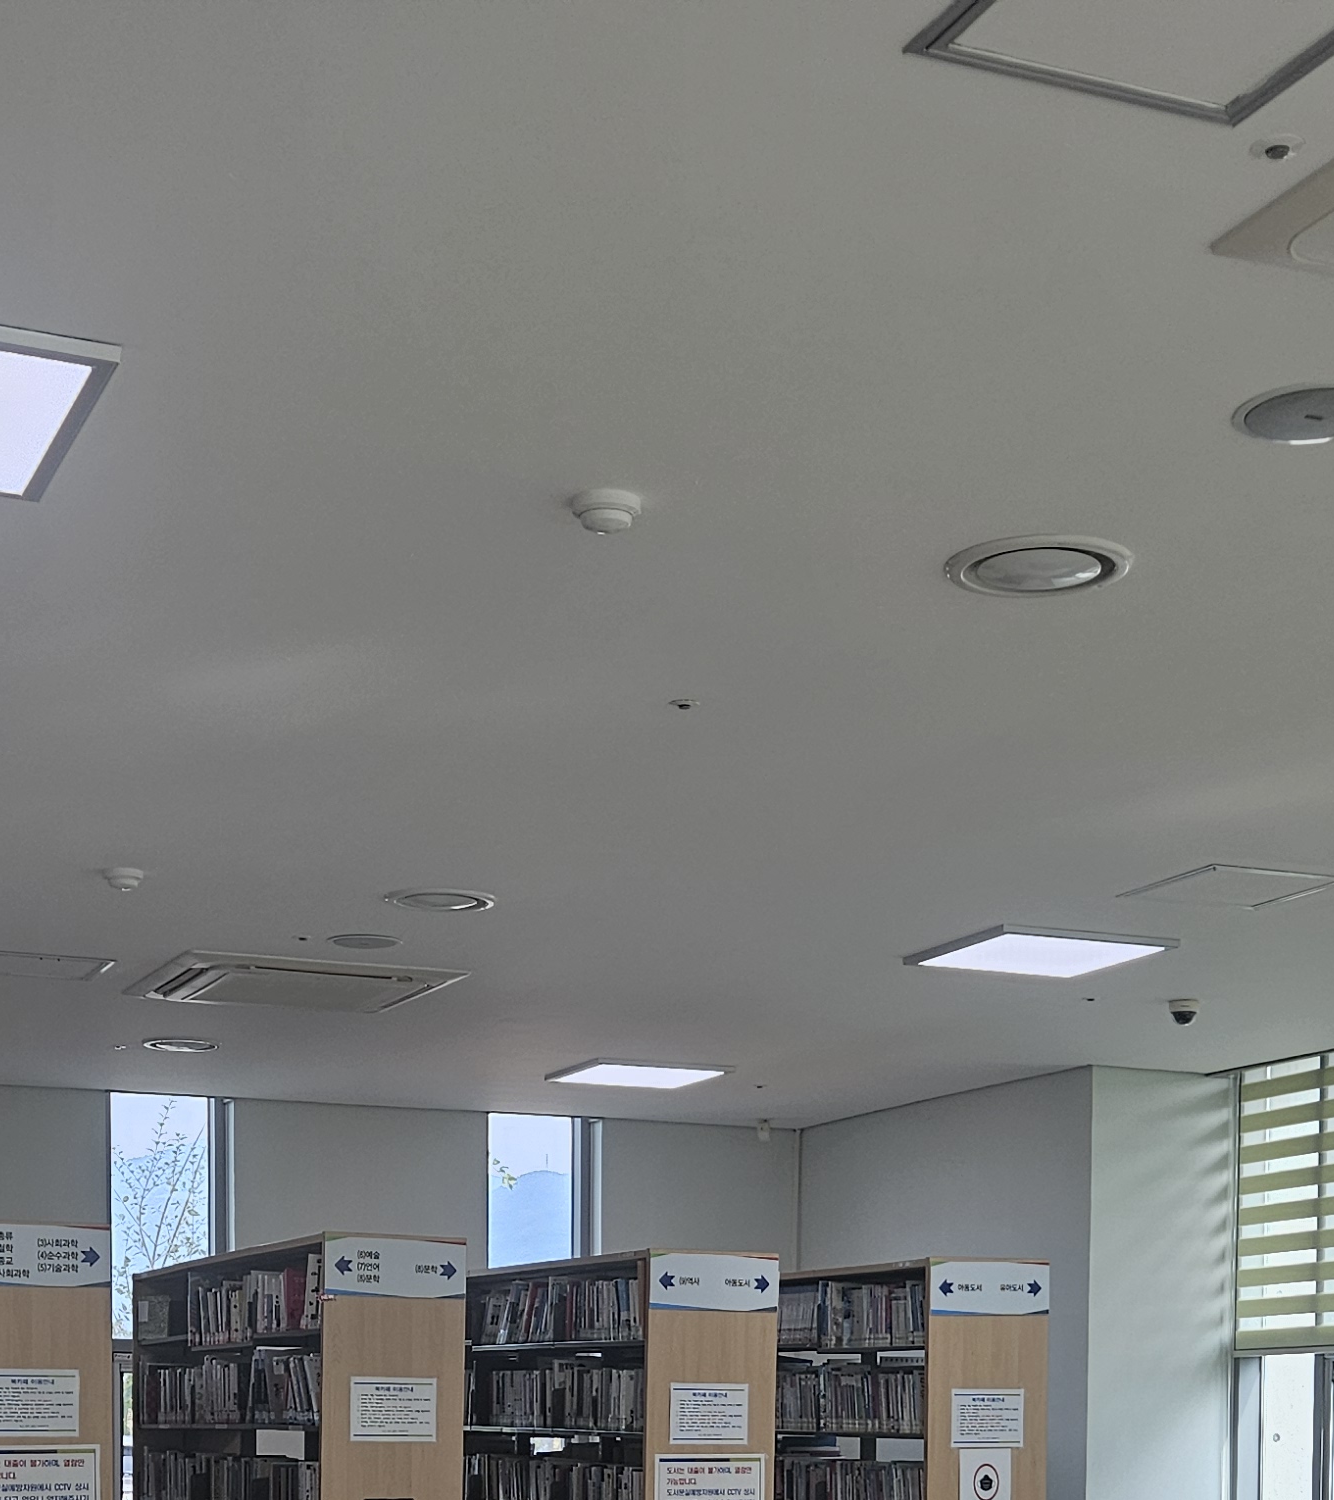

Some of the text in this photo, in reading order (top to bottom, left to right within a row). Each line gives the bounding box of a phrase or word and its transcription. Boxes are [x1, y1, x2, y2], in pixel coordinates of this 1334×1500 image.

[37, 1238, 78, 1248] (3)사회과학
[37, 1250, 79, 1261] (4)순수과학
[37, 1263, 79, 1273] (5)기술과학
[357, 1262, 380, 1272] (7)언어
[415, 1264, 438, 1274] (8)문학
[724, 1278, 750, 1287] 아동도서
[957, 1283, 983, 1292] 아동도서
[1000, 1284, 1024, 1292] 유아도서
[4, 1459, 27, 1468] 대출이
[54, 1483, 72, 1491] CCTV
[75, 1483, 89, 1491] 상시
[727, 1488, 742, 1496] CCTV
